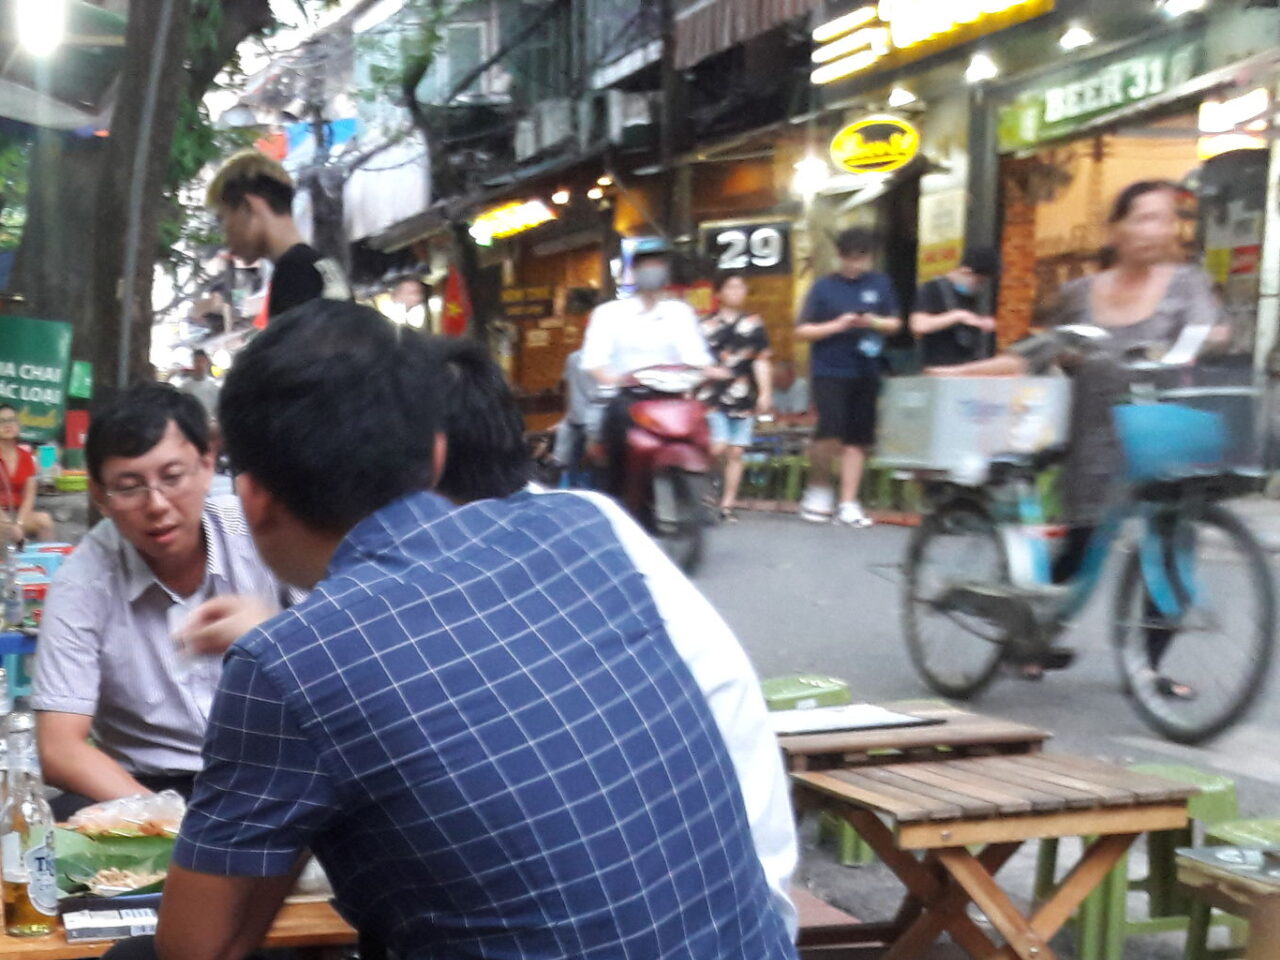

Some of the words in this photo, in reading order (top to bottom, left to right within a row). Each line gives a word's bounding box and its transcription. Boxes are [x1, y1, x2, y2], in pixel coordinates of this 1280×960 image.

[1043, 63, 1124, 123] BEER
[1126, 54, 1164, 99] 31
[716, 230, 782, 270] 29
[19, 364, 62, 383] CHAI
